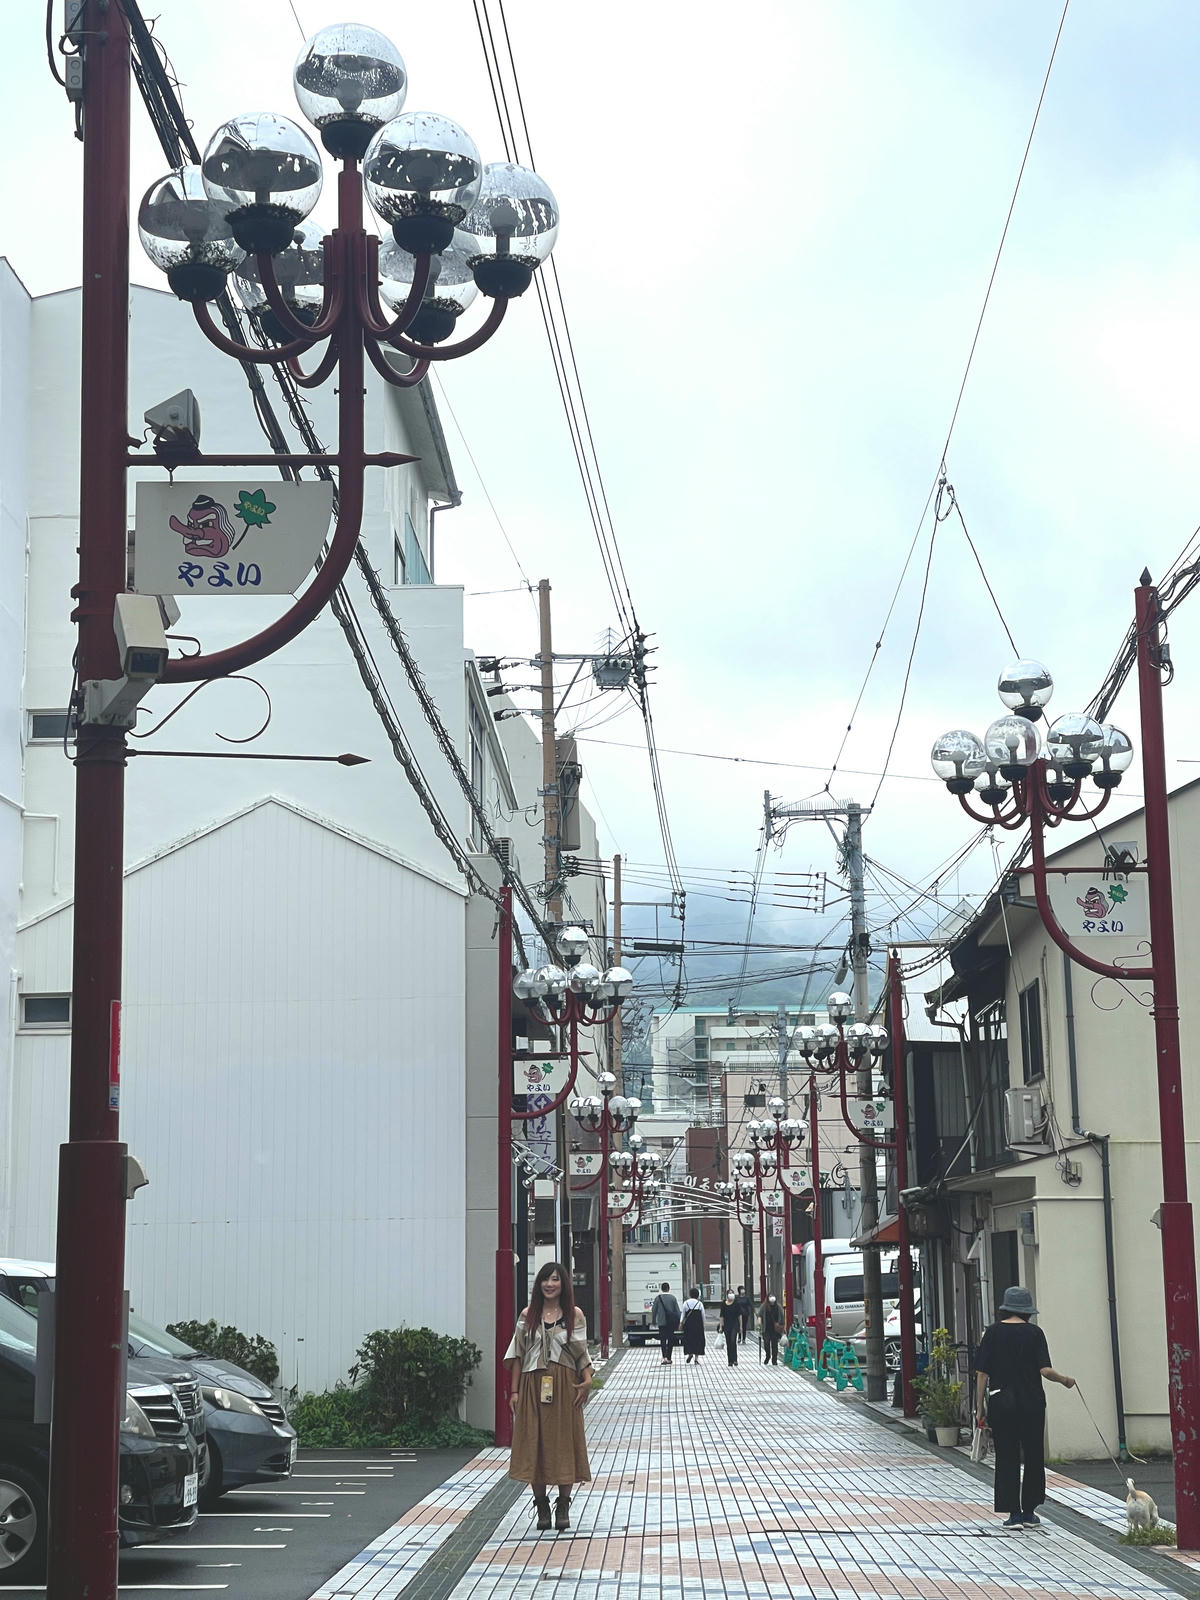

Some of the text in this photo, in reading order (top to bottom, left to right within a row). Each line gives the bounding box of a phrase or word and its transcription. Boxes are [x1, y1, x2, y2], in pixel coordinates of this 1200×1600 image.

[243, 501, 265, 516] やよい
[177, 561, 262, 588] やよい
[1082, 919, 1124, 933] やよい
[526, 1083, 551, 1092] やよい
[863, 1119, 884, 1127] やよい
